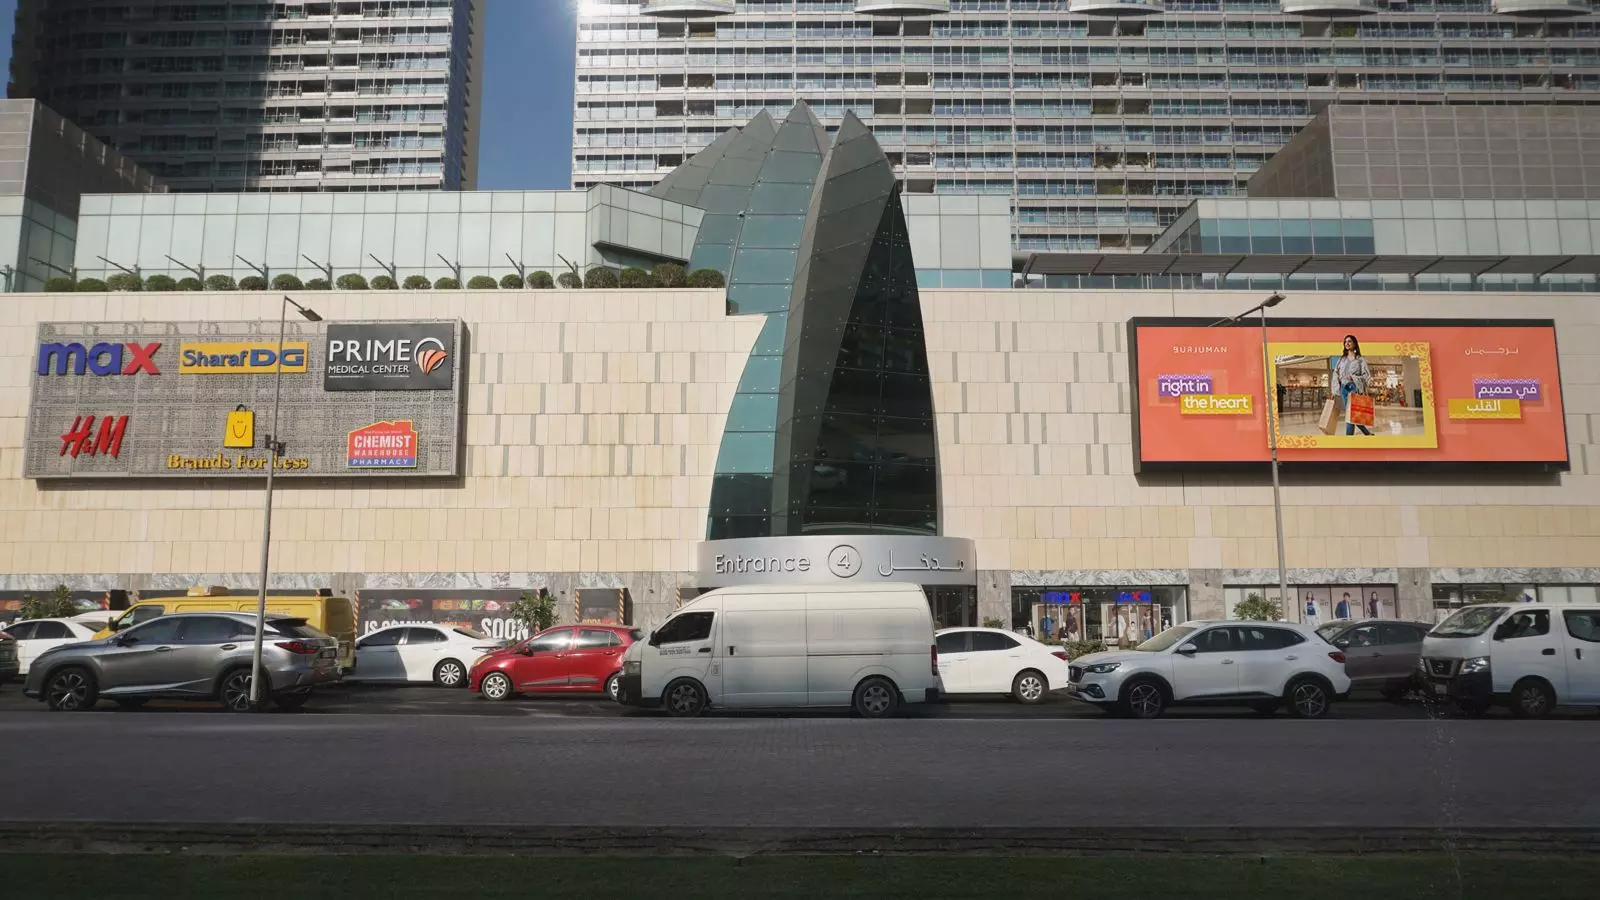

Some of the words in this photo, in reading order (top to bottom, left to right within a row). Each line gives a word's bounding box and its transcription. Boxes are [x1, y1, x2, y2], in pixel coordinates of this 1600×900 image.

[38, 342, 162, 376] max
[183, 350, 248, 368] Sharaf
[250, 349, 304, 367] DG
[328, 340, 411, 361] PRIME
[328, 365, 369, 374] MEDICAL
[372, 365, 409, 373] CENTER
[1161, 380, 1195, 397] right
[1196, 380, 1209, 392] in
[1478, 386, 1512, 398] صميم
[1516, 384, 1537, 399] في
[1184, 396, 1208, 409] the
[1209, 396, 1249, 409] heart
[1466, 399, 1501, 413] القلب
[60, 415, 129, 459] H&M
[354, 435, 411, 448] CHEMIST
[167, 453, 231, 469] Brands
[236, 455, 267, 469] For
[273, 455, 309, 469] Less
[715, 554, 811, 573] Entrance
[836, 552, 851, 569] 4
[878, 549, 965, 576] مدخل
[481, 618, 529, 640] SOON
